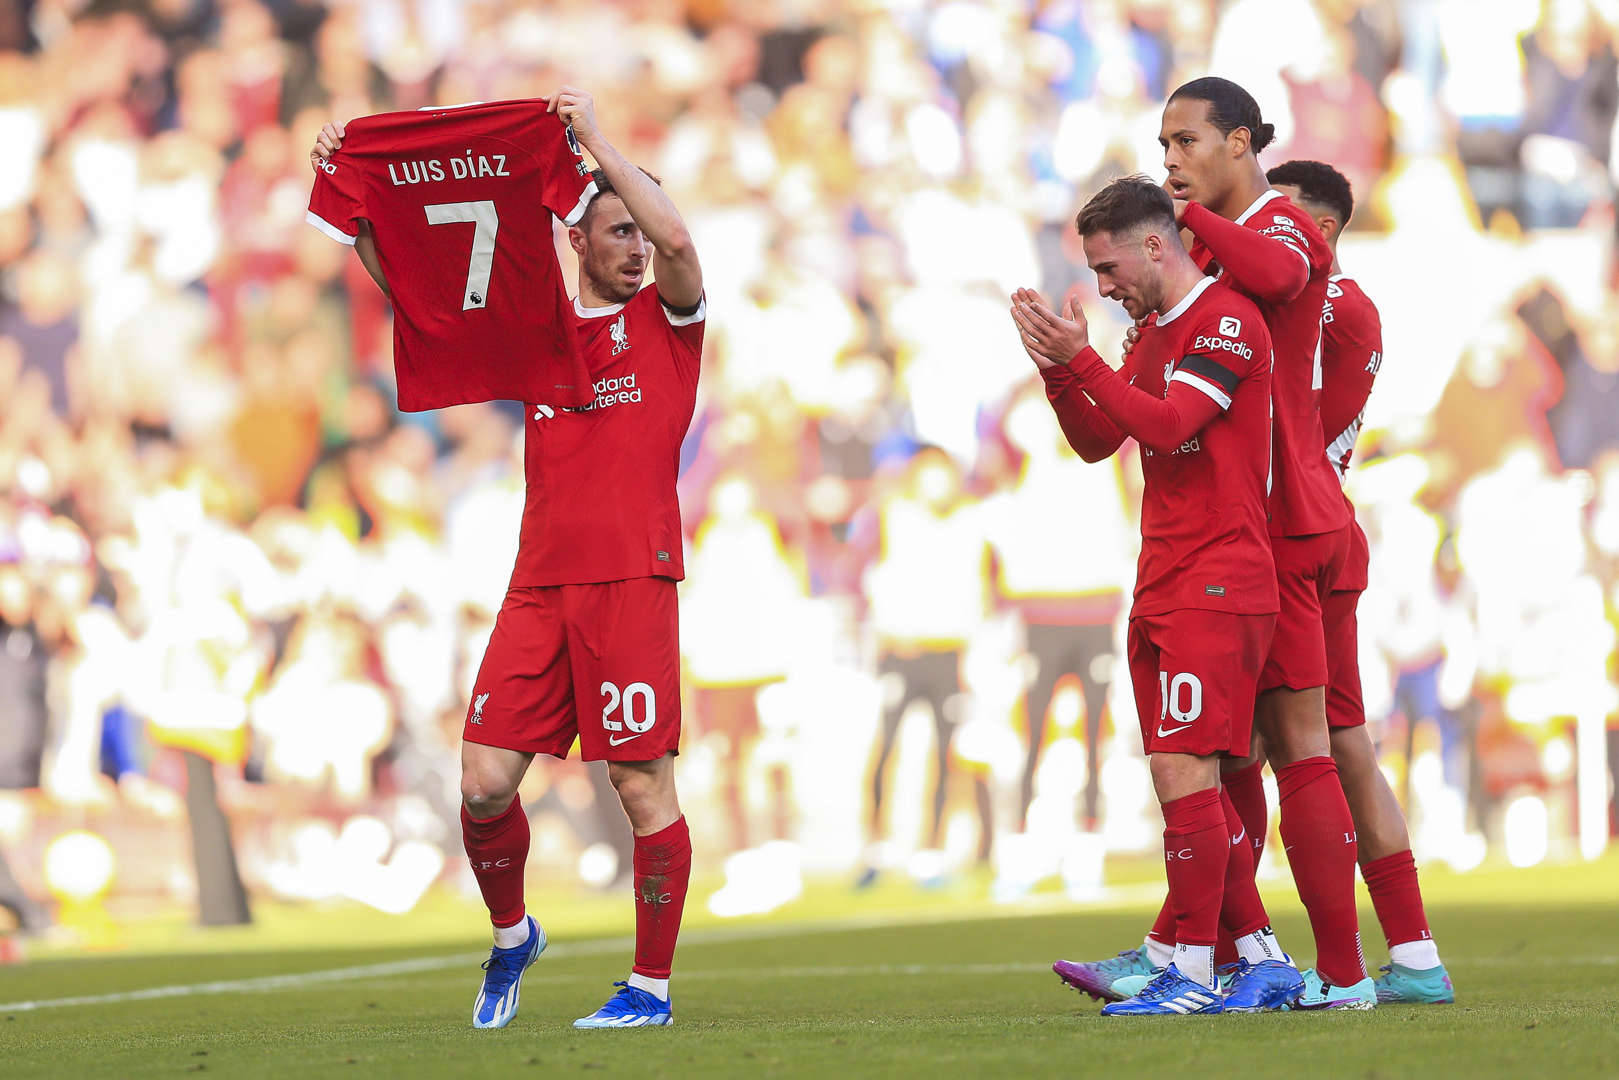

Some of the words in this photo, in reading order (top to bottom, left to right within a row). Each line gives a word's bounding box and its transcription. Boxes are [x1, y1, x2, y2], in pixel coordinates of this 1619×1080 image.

[388, 159, 446, 186] LUIS
[449, 149, 510, 180] DÍAZ
[424, 200, 499, 311] 7
[1257, 225, 1310, 249] xpedia
[1194, 335, 1254, 360] Expedia
[600, 681, 656, 733] 20
[1159, 671, 1203, 723] 10
